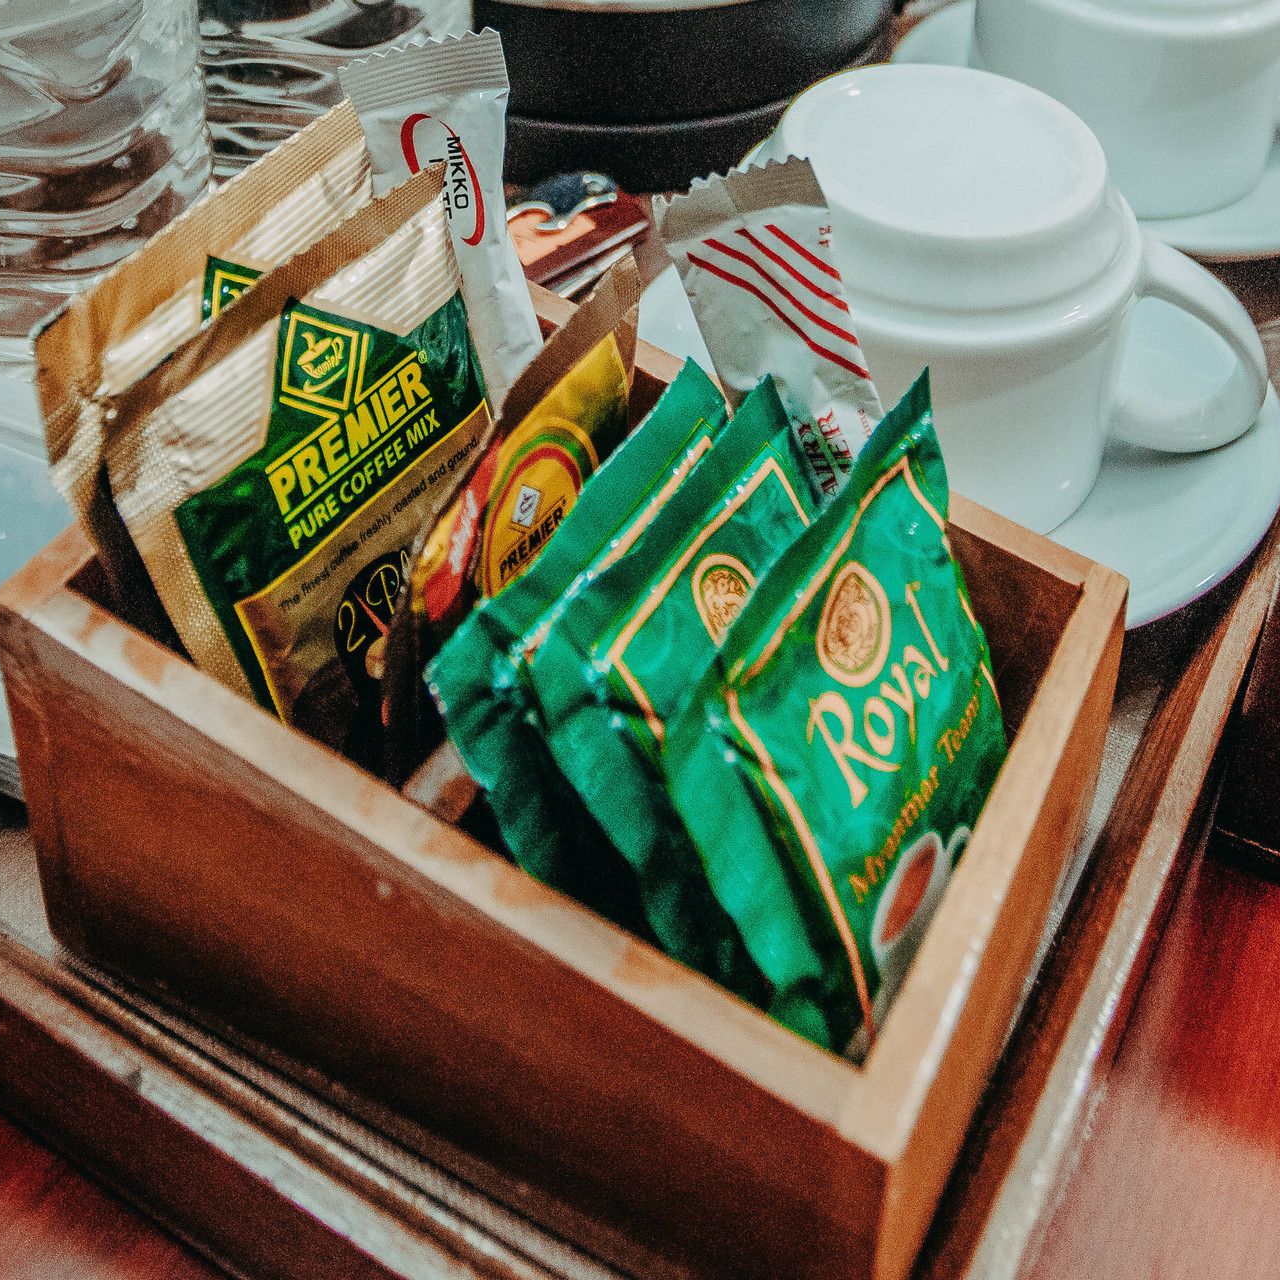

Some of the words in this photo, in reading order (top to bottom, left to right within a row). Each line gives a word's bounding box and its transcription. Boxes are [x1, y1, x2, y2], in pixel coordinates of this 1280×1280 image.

[446, 136, 469, 209] MIKKO
[268, 361, 432, 517] PREMIER
[288, 495, 341, 551] PURE
[339, 436, 407, 505] COFFEE
[406, 408, 442, 452] MIX
[301, 564, 332, 596] finest
[329, 540, 360, 571] coffee
[358, 512, 393, 544] freshly
[391, 480, 428, 517] roasted
[426, 464, 447, 487] and
[498, 506, 565, 581] PREMIER
[806, 580, 950, 809] Royal
